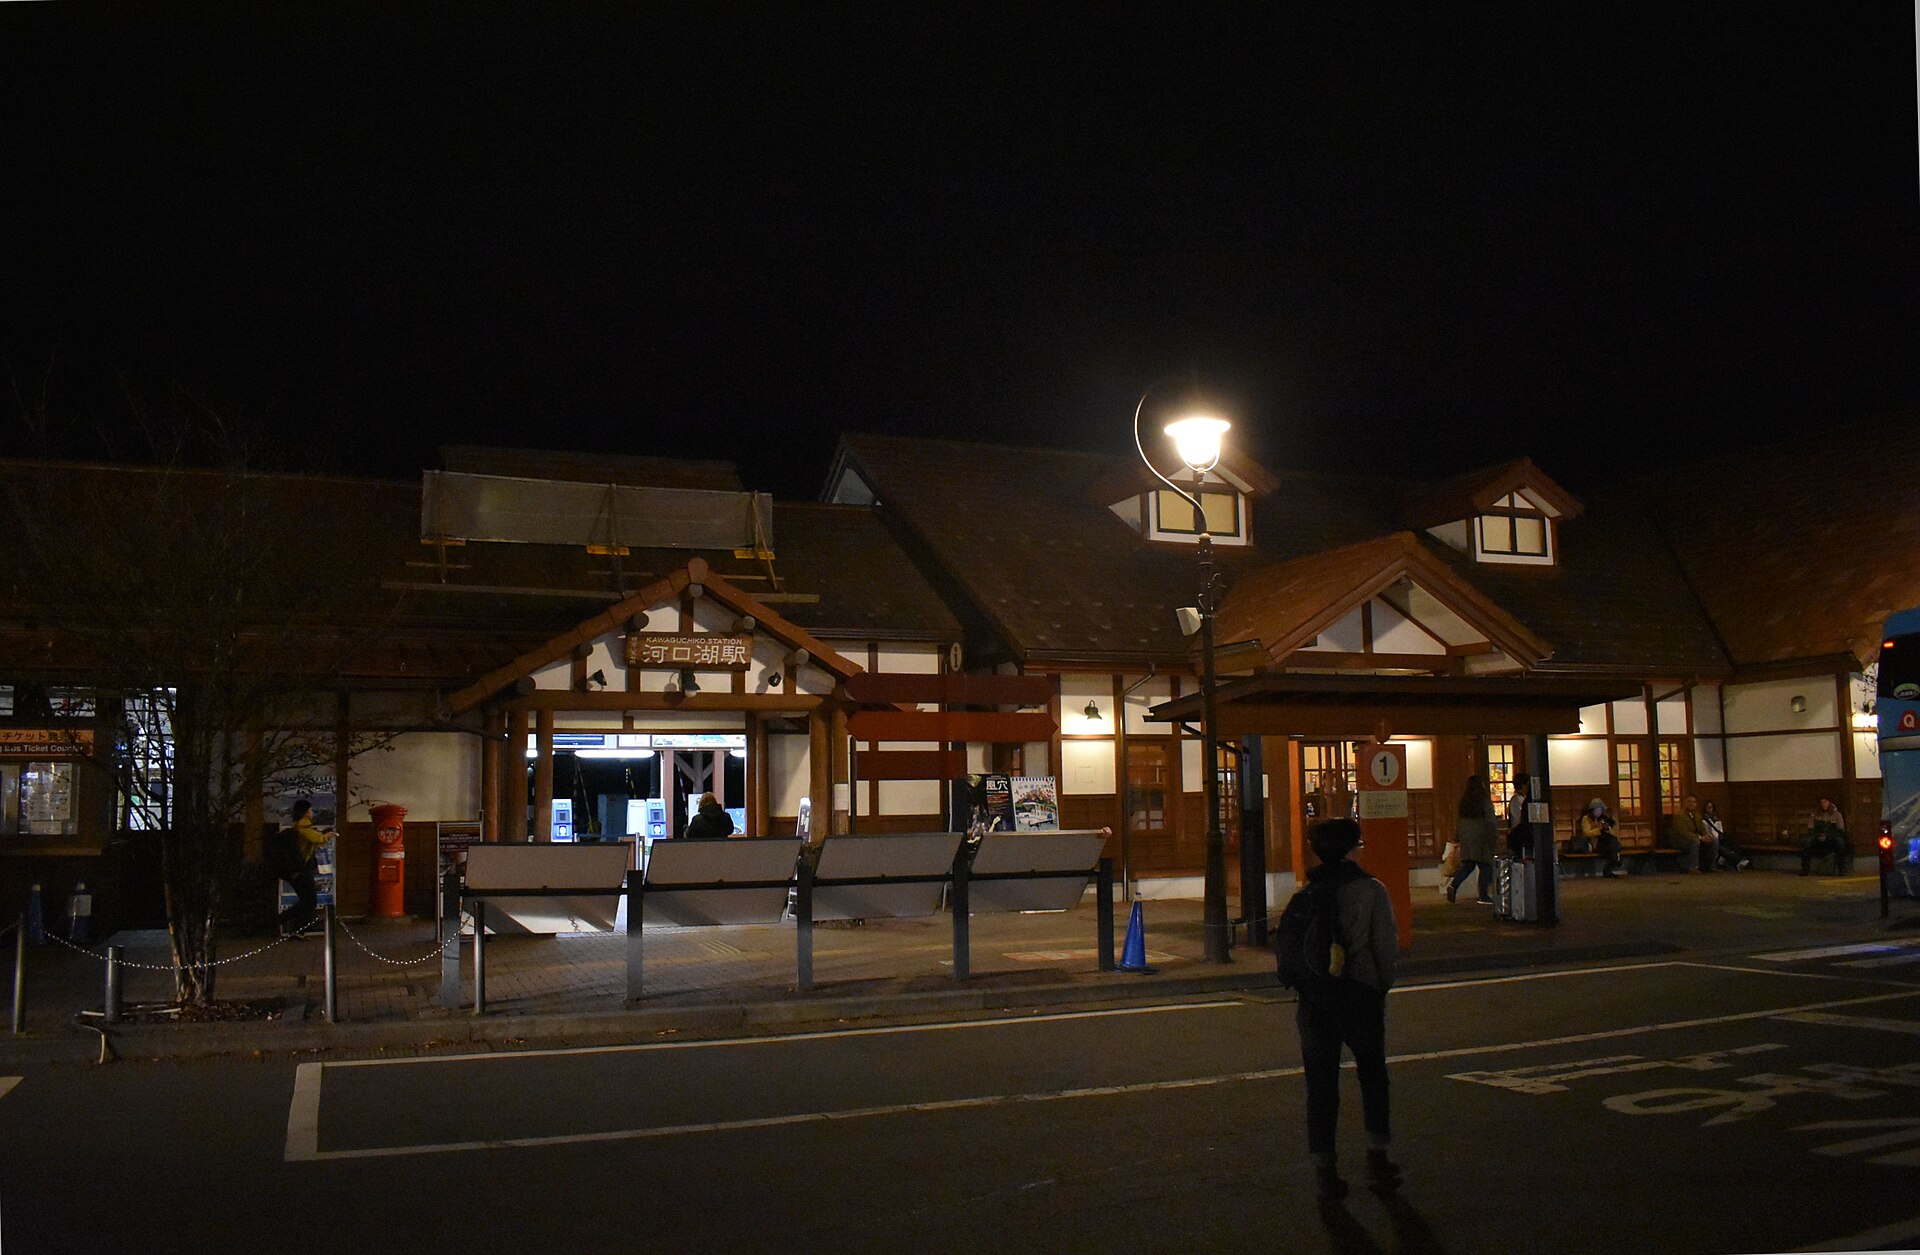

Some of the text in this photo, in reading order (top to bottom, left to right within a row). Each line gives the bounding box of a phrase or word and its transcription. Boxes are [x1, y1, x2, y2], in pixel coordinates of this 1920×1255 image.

[646, 636, 706, 644] KAWAGUCHIKO
[642, 644, 746, 665] 河口湖駅
[23, 744, 48, 752] Ticket
[1379, 755, 1387, 776] 1
